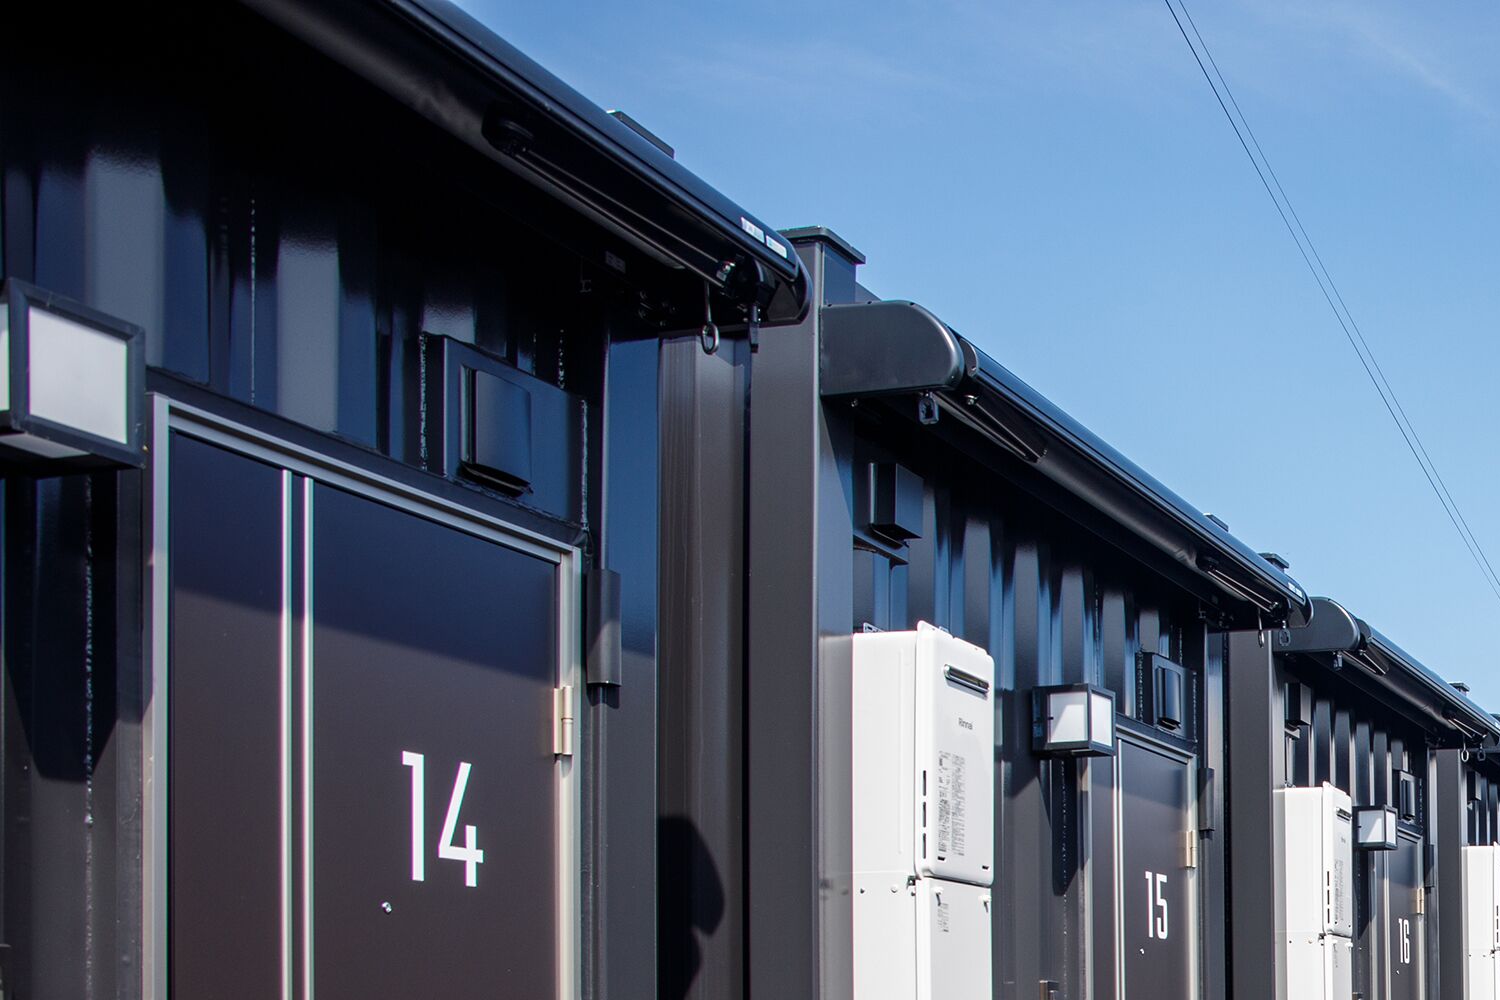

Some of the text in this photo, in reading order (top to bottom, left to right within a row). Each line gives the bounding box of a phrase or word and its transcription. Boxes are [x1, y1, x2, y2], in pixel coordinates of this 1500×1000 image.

[402, 750, 484, 888] 14
[1144, 870, 1169, 940] 15
[1398, 917, 1411, 966] 16
